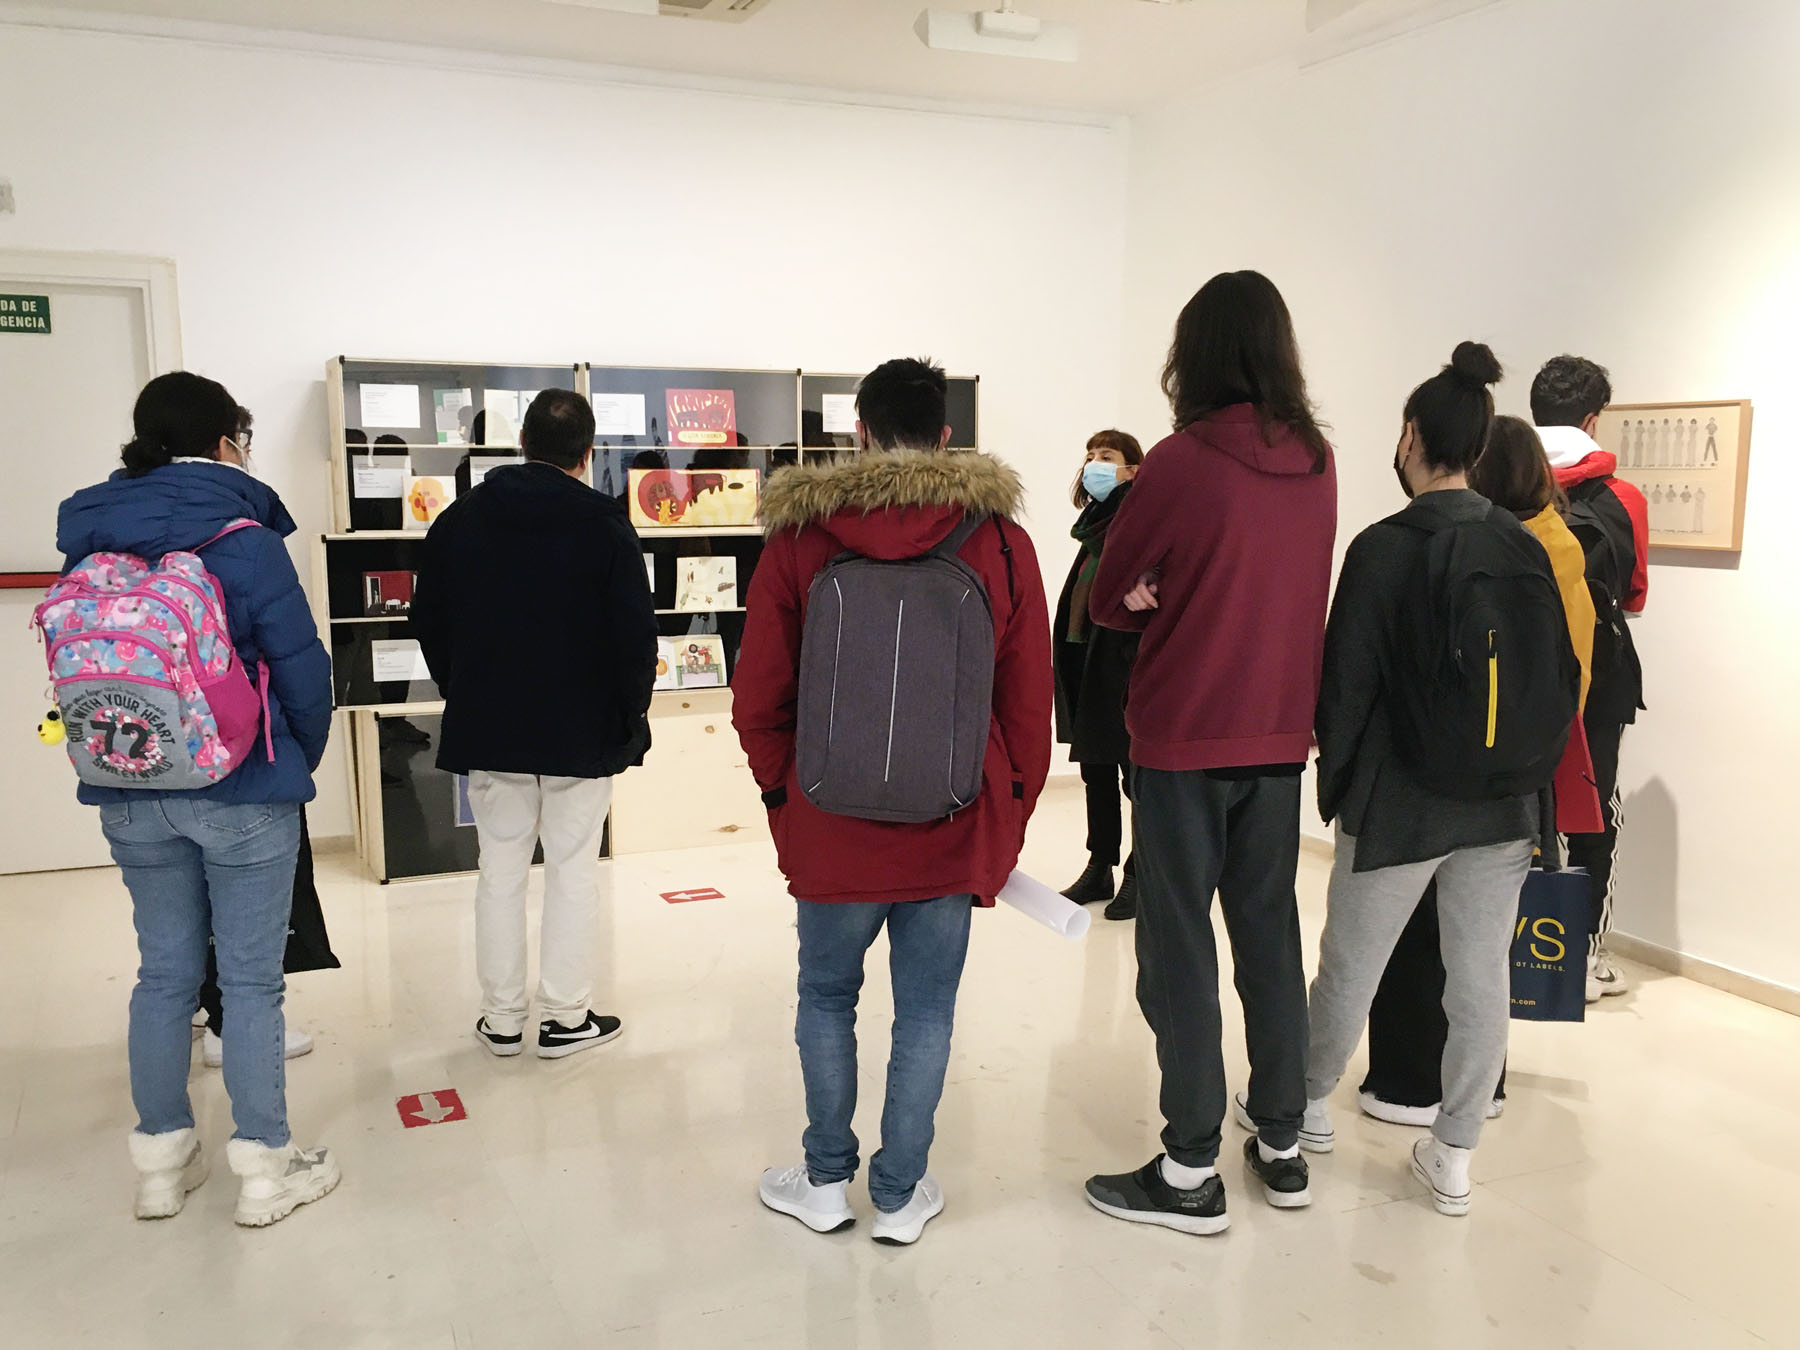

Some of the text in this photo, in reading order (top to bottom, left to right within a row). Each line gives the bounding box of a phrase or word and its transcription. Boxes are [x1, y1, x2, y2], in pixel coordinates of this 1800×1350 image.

[22, 300, 37, 312] DE
[0, 315, 45, 328] GENCIA
[71, 697, 104, 722] WITH
[103, 693, 140, 713] YOUR
[68, 722, 85, 743] RUN
[140, 708, 176, 745] HEART
[89, 719, 150, 760] 72
